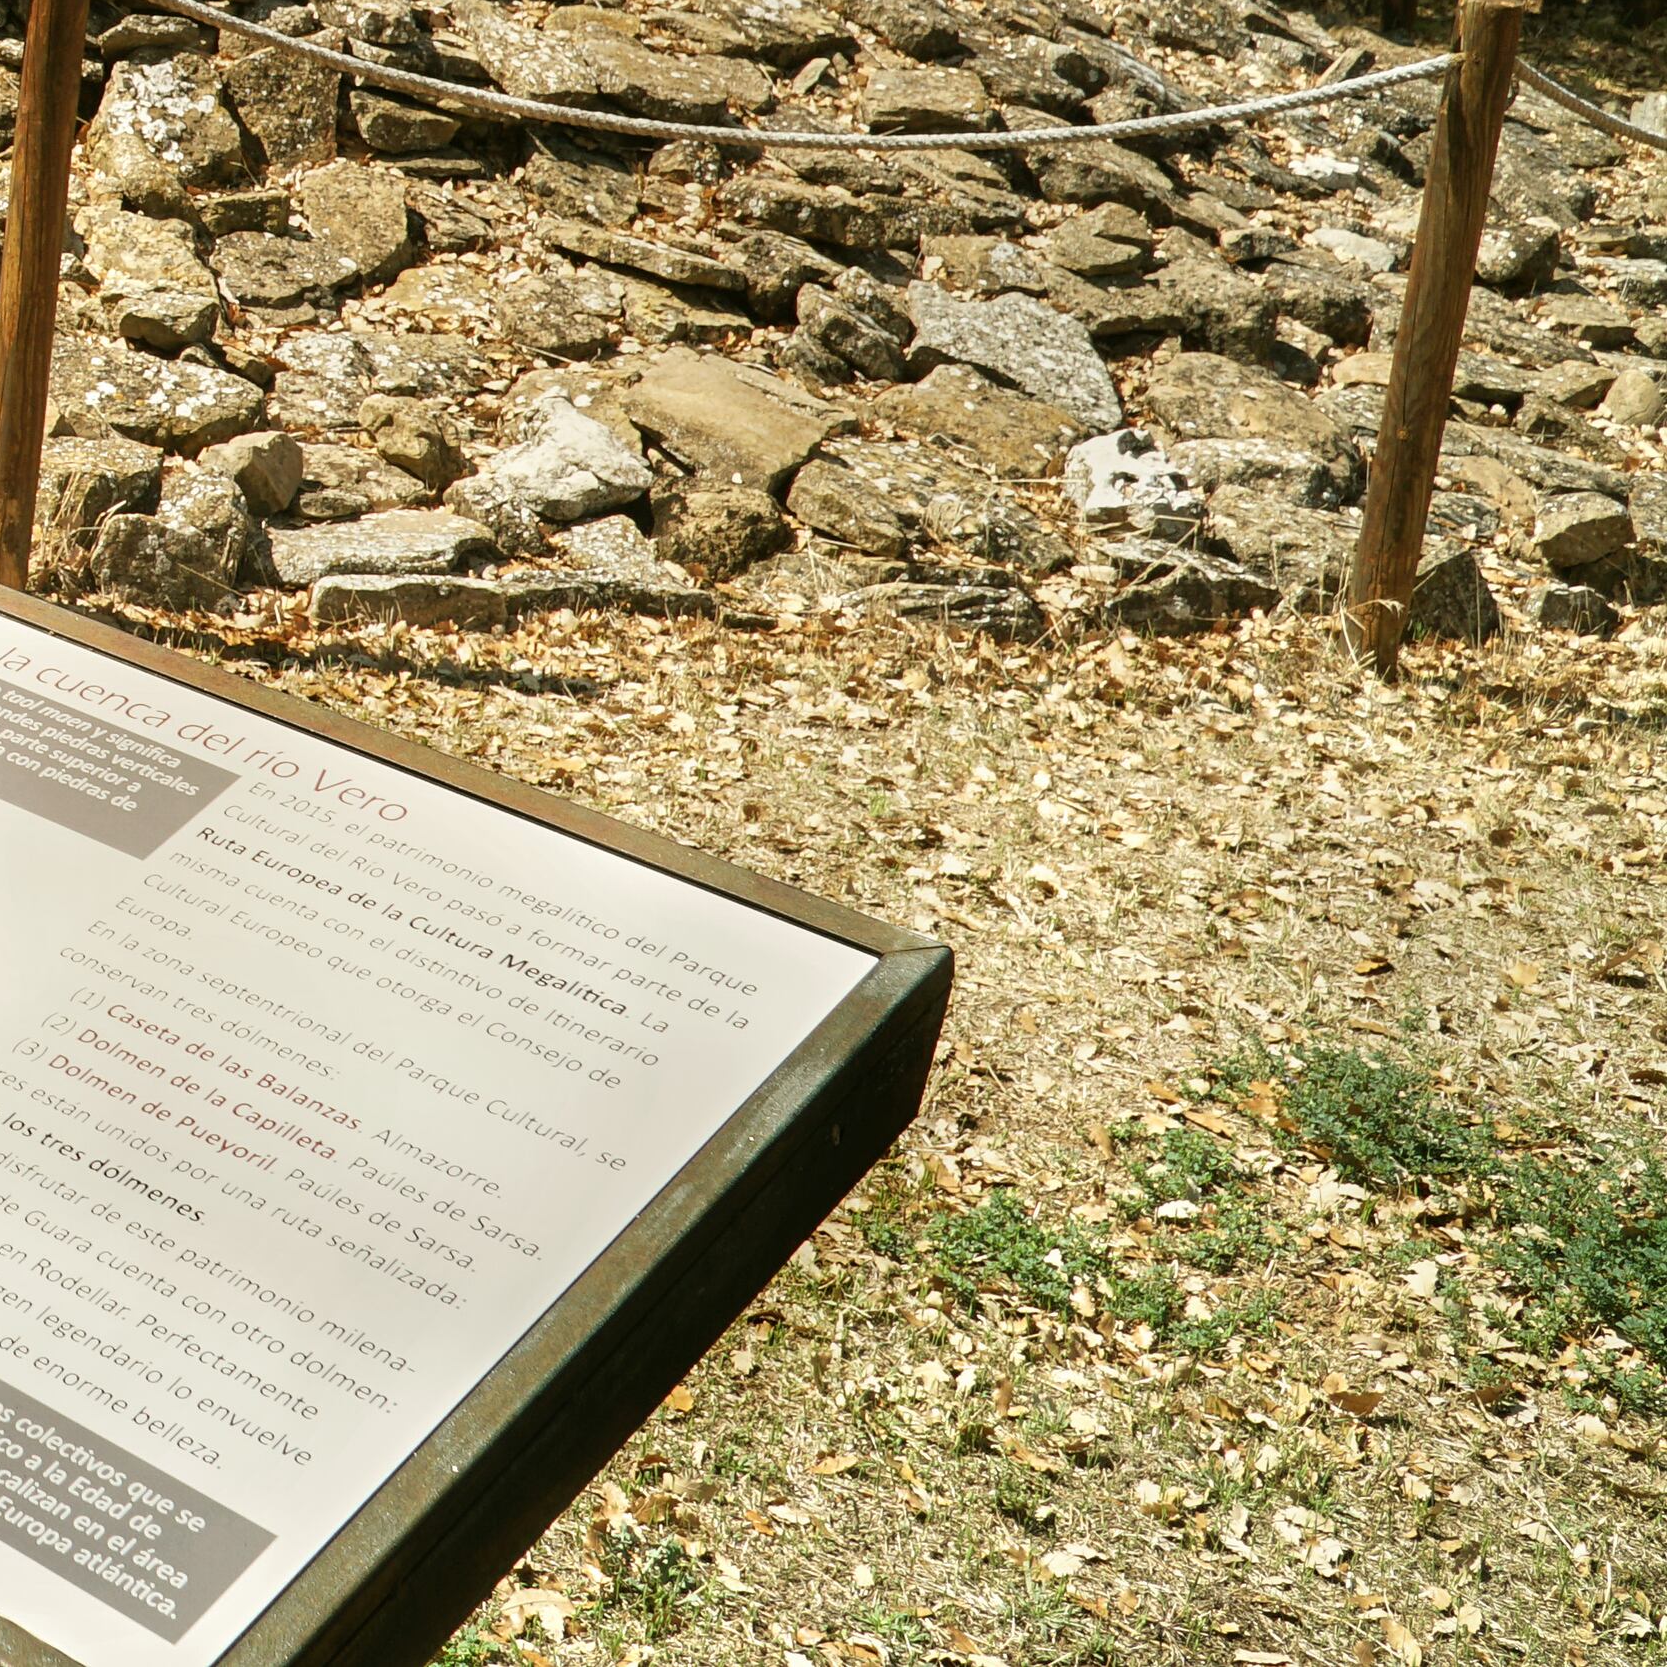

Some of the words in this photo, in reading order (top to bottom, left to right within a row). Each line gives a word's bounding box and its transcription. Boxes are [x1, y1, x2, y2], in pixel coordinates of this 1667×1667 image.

[1, 689, 45, 710] taol
[37, 705, 92, 732] maen
[89, 725, 108, 739] y
[104, 732, 181, 768] significa
[5, 751, 41, 771] con
[37, 765, 111, 800] piedras
[109, 794, 137, 812] de
[34, 667, 172, 728] cuenca
[175, 723, 246, 755] del
[241, 748, 300, 779] río
[312, 767, 408, 822] Vero
[38, 725, 110, 759] piedras
[110, 753, 200, 796] verticales
[47, 748, 129, 786] superior
[126, 781, 142, 793] a
[195, 826, 247, 855] Ruta
[249, 849, 343, 895] Europea
[346, 891, 377, 910] de
[380, 902, 403, 921] la
[407, 915, 494, 959] Cultura
[498, 952, 628, 1020] Megalítica.
[639, 1012, 669, 1033] La
[247, 780, 276, 800] En
[278, 793, 336, 827] 2015,
[343, 822, 369, 836] el
[365, 832, 494, 888] patrimonio
[497, 884, 620, 940] megalítico
[623, 935, 668, 958] del
[668, 950, 758, 996] Parque
[69, 989, 106, 1009] (1)
[106, 1003, 181, 1046] Caseta
[183, 1041, 215, 1062] de
[217, 1054, 253, 1079] las
[255, 1072, 362, 1135] Balanzas.
[371, 1128, 500, 1199] Almazorre.
[86, 919, 116, 940] En
[118, 932, 140, 951] la
[141, 946, 195, 976] zona
[196, 971, 353, 1045] septentrional
[351, 1041, 394, 1064] del
[393, 1057, 480, 1105] Parque
[484, 1098, 588, 1157] Cultural,
[594, 1151, 627, 1171] se
[1, 1111, 37, 1137] los
[39, 1131, 86, 1162] tres
[87, 1158, 205, 1228] dólmenes.
[11, 1041, 48, 1059] (3)
[47, 1053, 137, 1105] Dolmen
[140, 1100, 172, 1122] de
[173, 1114, 278, 1176] Pueyoril.
[284, 1167, 364, 1215] Paúles
[367, 1211, 402, 1233] de
[403, 1226, 475, 1272] Sarsa.
[40, 1015, 77, 1032] (2)
[76, 1027, 167, 1078] Dolmen
[168, 1074, 201, 1095] de
[203, 1087, 227, 1108] la
[231, 1101, 336, 1163] Capilleta.
[347, 1155, 428, 1203] Paúles
[431, 1199, 466, 1221] de
[468, 1214, 541, 1261] Sarsa.
[30, 1257, 131, 1320] Rodellar.
[135, 1312, 319, 1420] Perfectamente
[89, 1202, 122, 1224] de
[124, 1220, 176, 1252] este
[174, 1247, 316, 1323] patrimonio
[317, 1319, 415, 1373] milena-
[14, 1417, 127, 1487] colectivos
[126, 1481, 174, 1515] que
[173, 1508, 206, 1533] se
[23, 1453, 42, 1471] a
[41, 1459, 67, 1485] la
[67, 1475, 133, 1520] Edad
[128, 1513, 162, 1540] de
[72, 1514, 105, 1540] en
[106, 1534, 137, 1556] el
[131, 1547, 188, 1589] área
[72, 1547, 176, 1620] atlántica.
